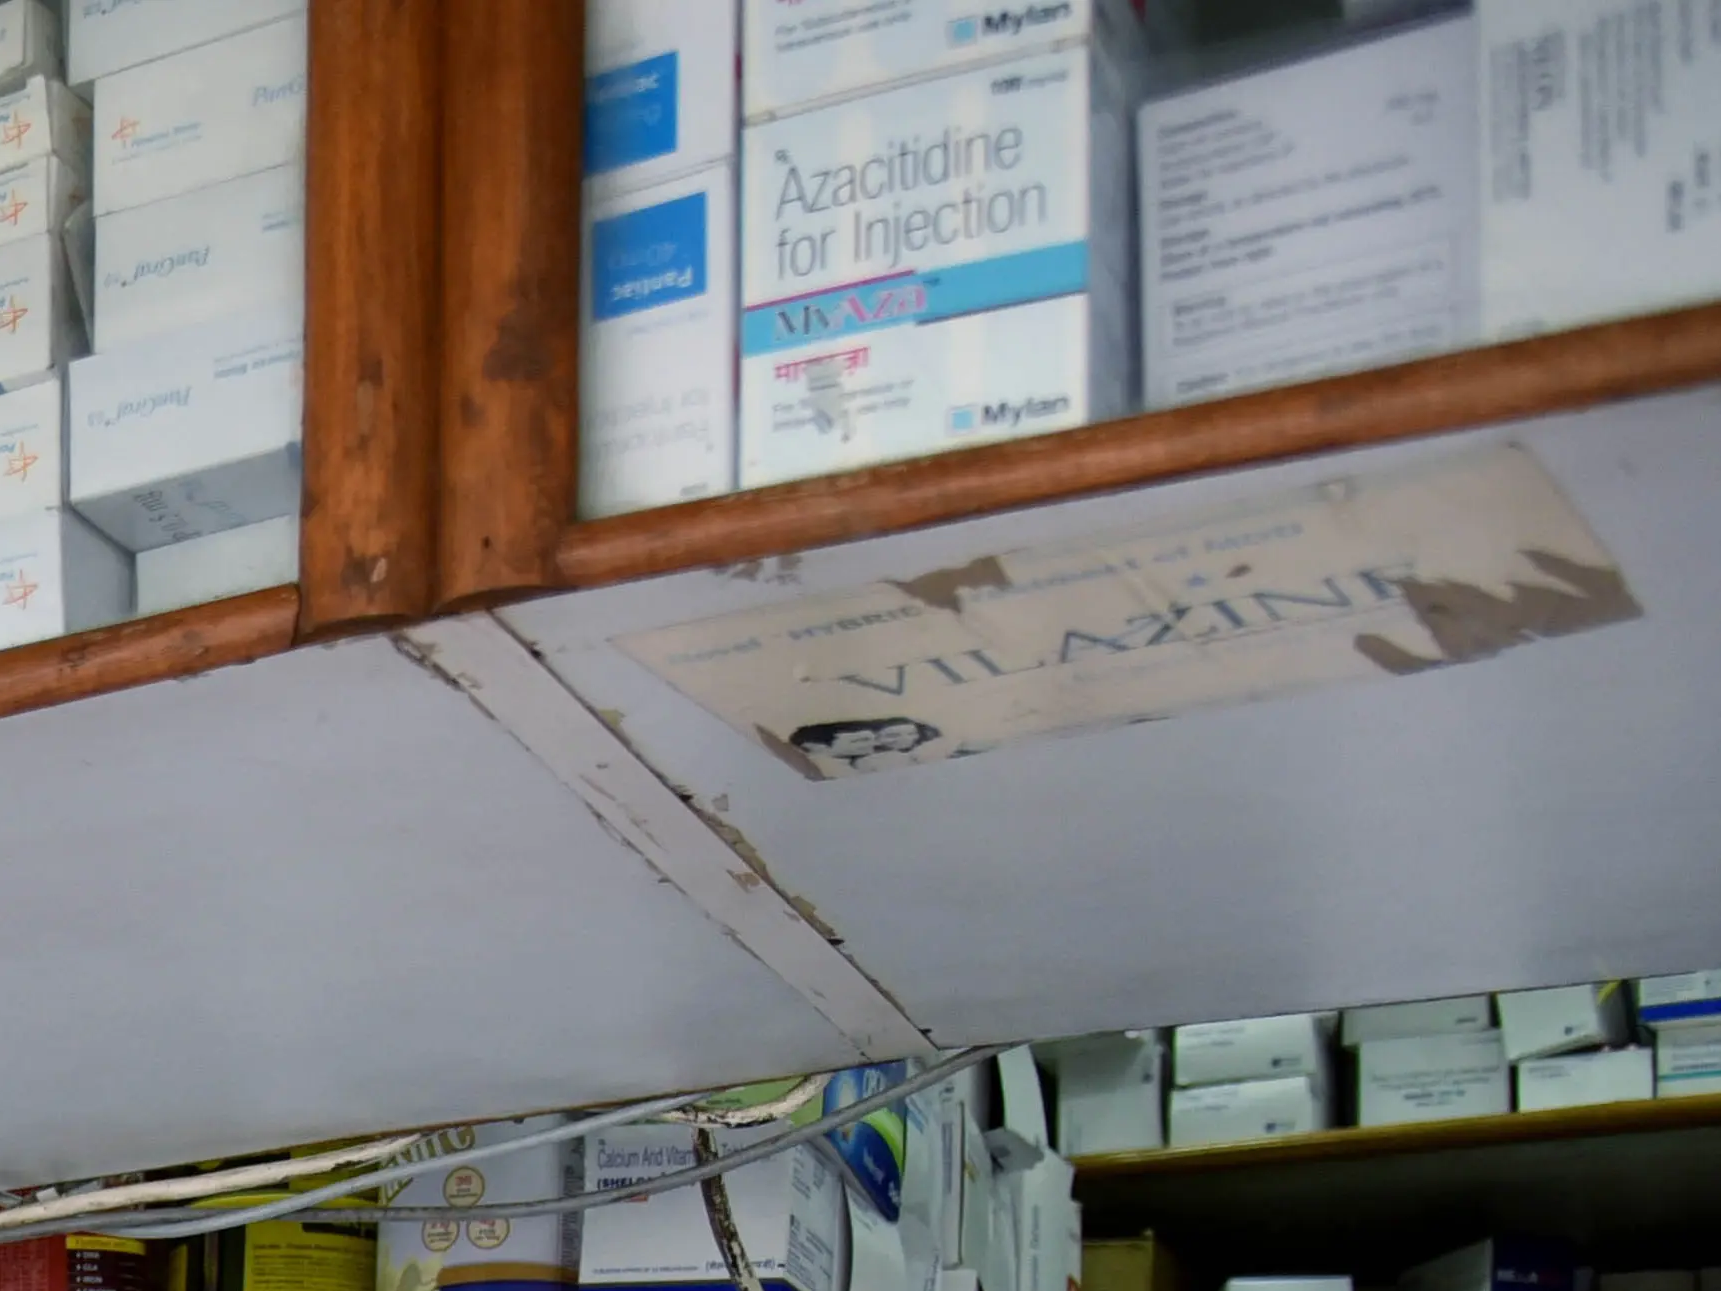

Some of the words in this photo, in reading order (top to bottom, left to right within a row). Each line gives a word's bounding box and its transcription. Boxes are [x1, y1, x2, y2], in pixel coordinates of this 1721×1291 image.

[774, 124, 1025, 221] Azacitidine
[775, 227, 838, 281] for
[851, 180, 1050, 267] Injection
[981, 393, 1072, 427] Mylan
[596, 1147, 640, 1169] Calcium
[641, 1146, 664, 1168] And
